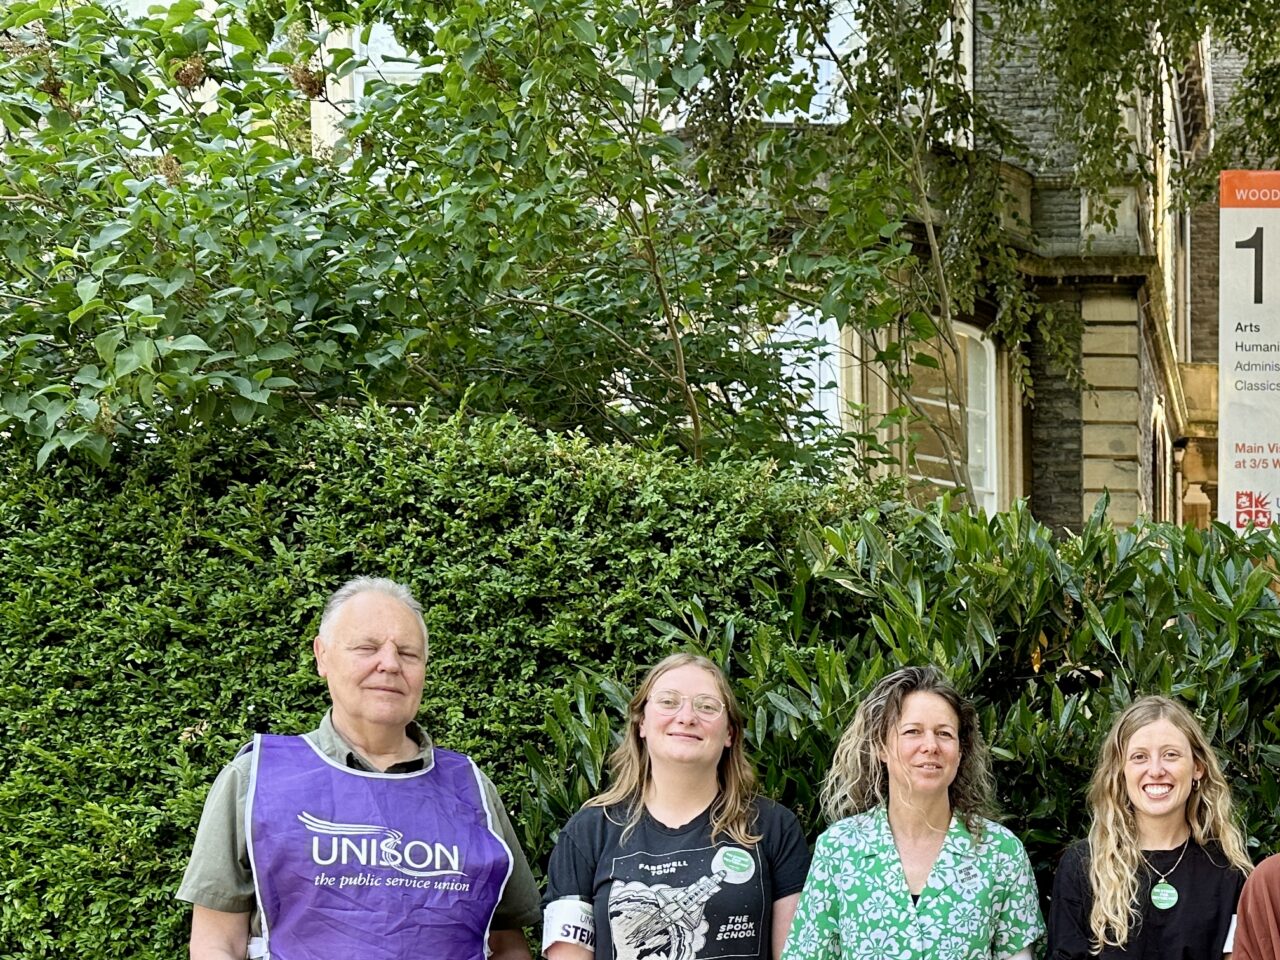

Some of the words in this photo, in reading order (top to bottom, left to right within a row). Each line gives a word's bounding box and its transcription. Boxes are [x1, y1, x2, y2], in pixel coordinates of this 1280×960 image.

[1235, 322, 1261, 333] Arts
[1235, 443, 1264, 454] Main
[1234, 459, 1246, 469] at
[1249, 459, 1269, 469] 3/5
[312, 836, 459, 871] UNISON
[638, 861, 689, 871] FAREWELL
[650, 867, 677, 876] TOUR
[314, 873, 336, 886] the
[339, 873, 382, 888] public
[385, 876, 430, 889] service
[433, 878, 470, 892] union
[728, 915, 749, 923] THE
[719, 922, 755, 932] SPOOK
[716, 930, 756, 940] SCHOOL
